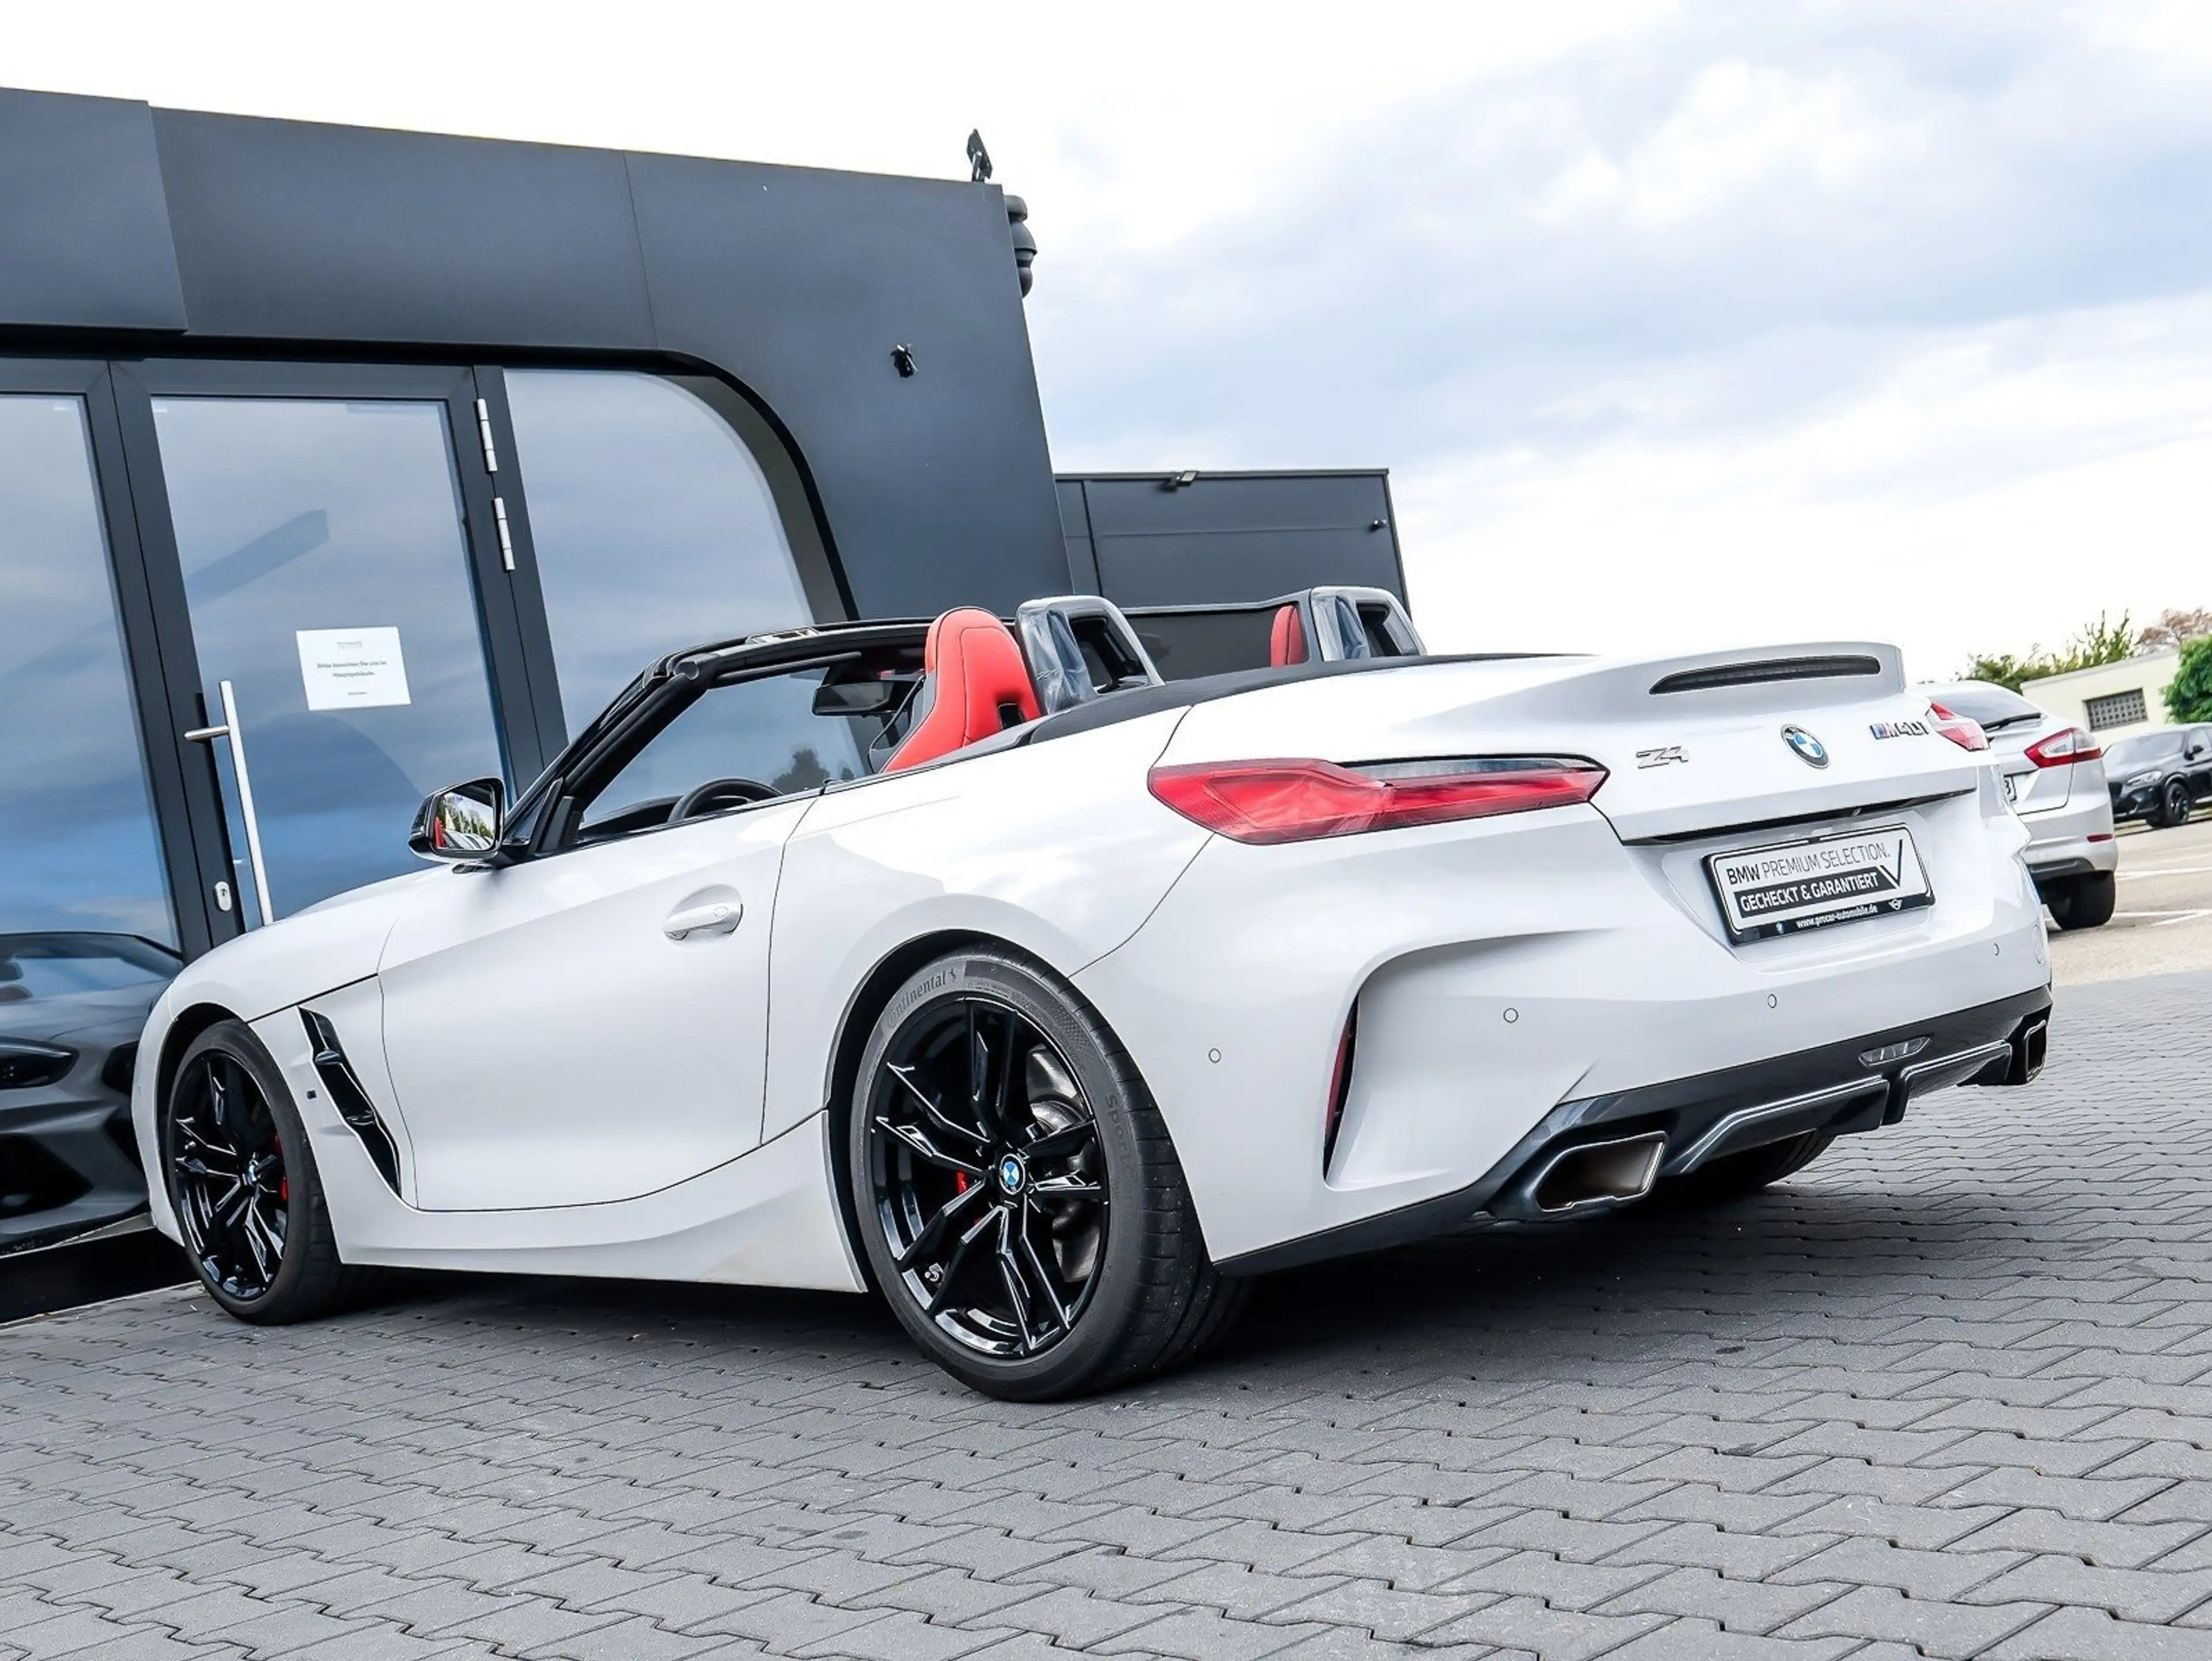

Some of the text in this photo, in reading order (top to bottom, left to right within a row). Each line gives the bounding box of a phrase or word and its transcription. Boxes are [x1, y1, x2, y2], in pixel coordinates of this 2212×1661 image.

[1636, 745, 1690, 769] Z4
[1726, 863, 1761, 885] BMW
[1762, 854, 1820, 880] PREMIUM
[1740, 871, 1880, 912] GECHECKT & GARANTIERT
[887, 969, 947, 1029] Continental
